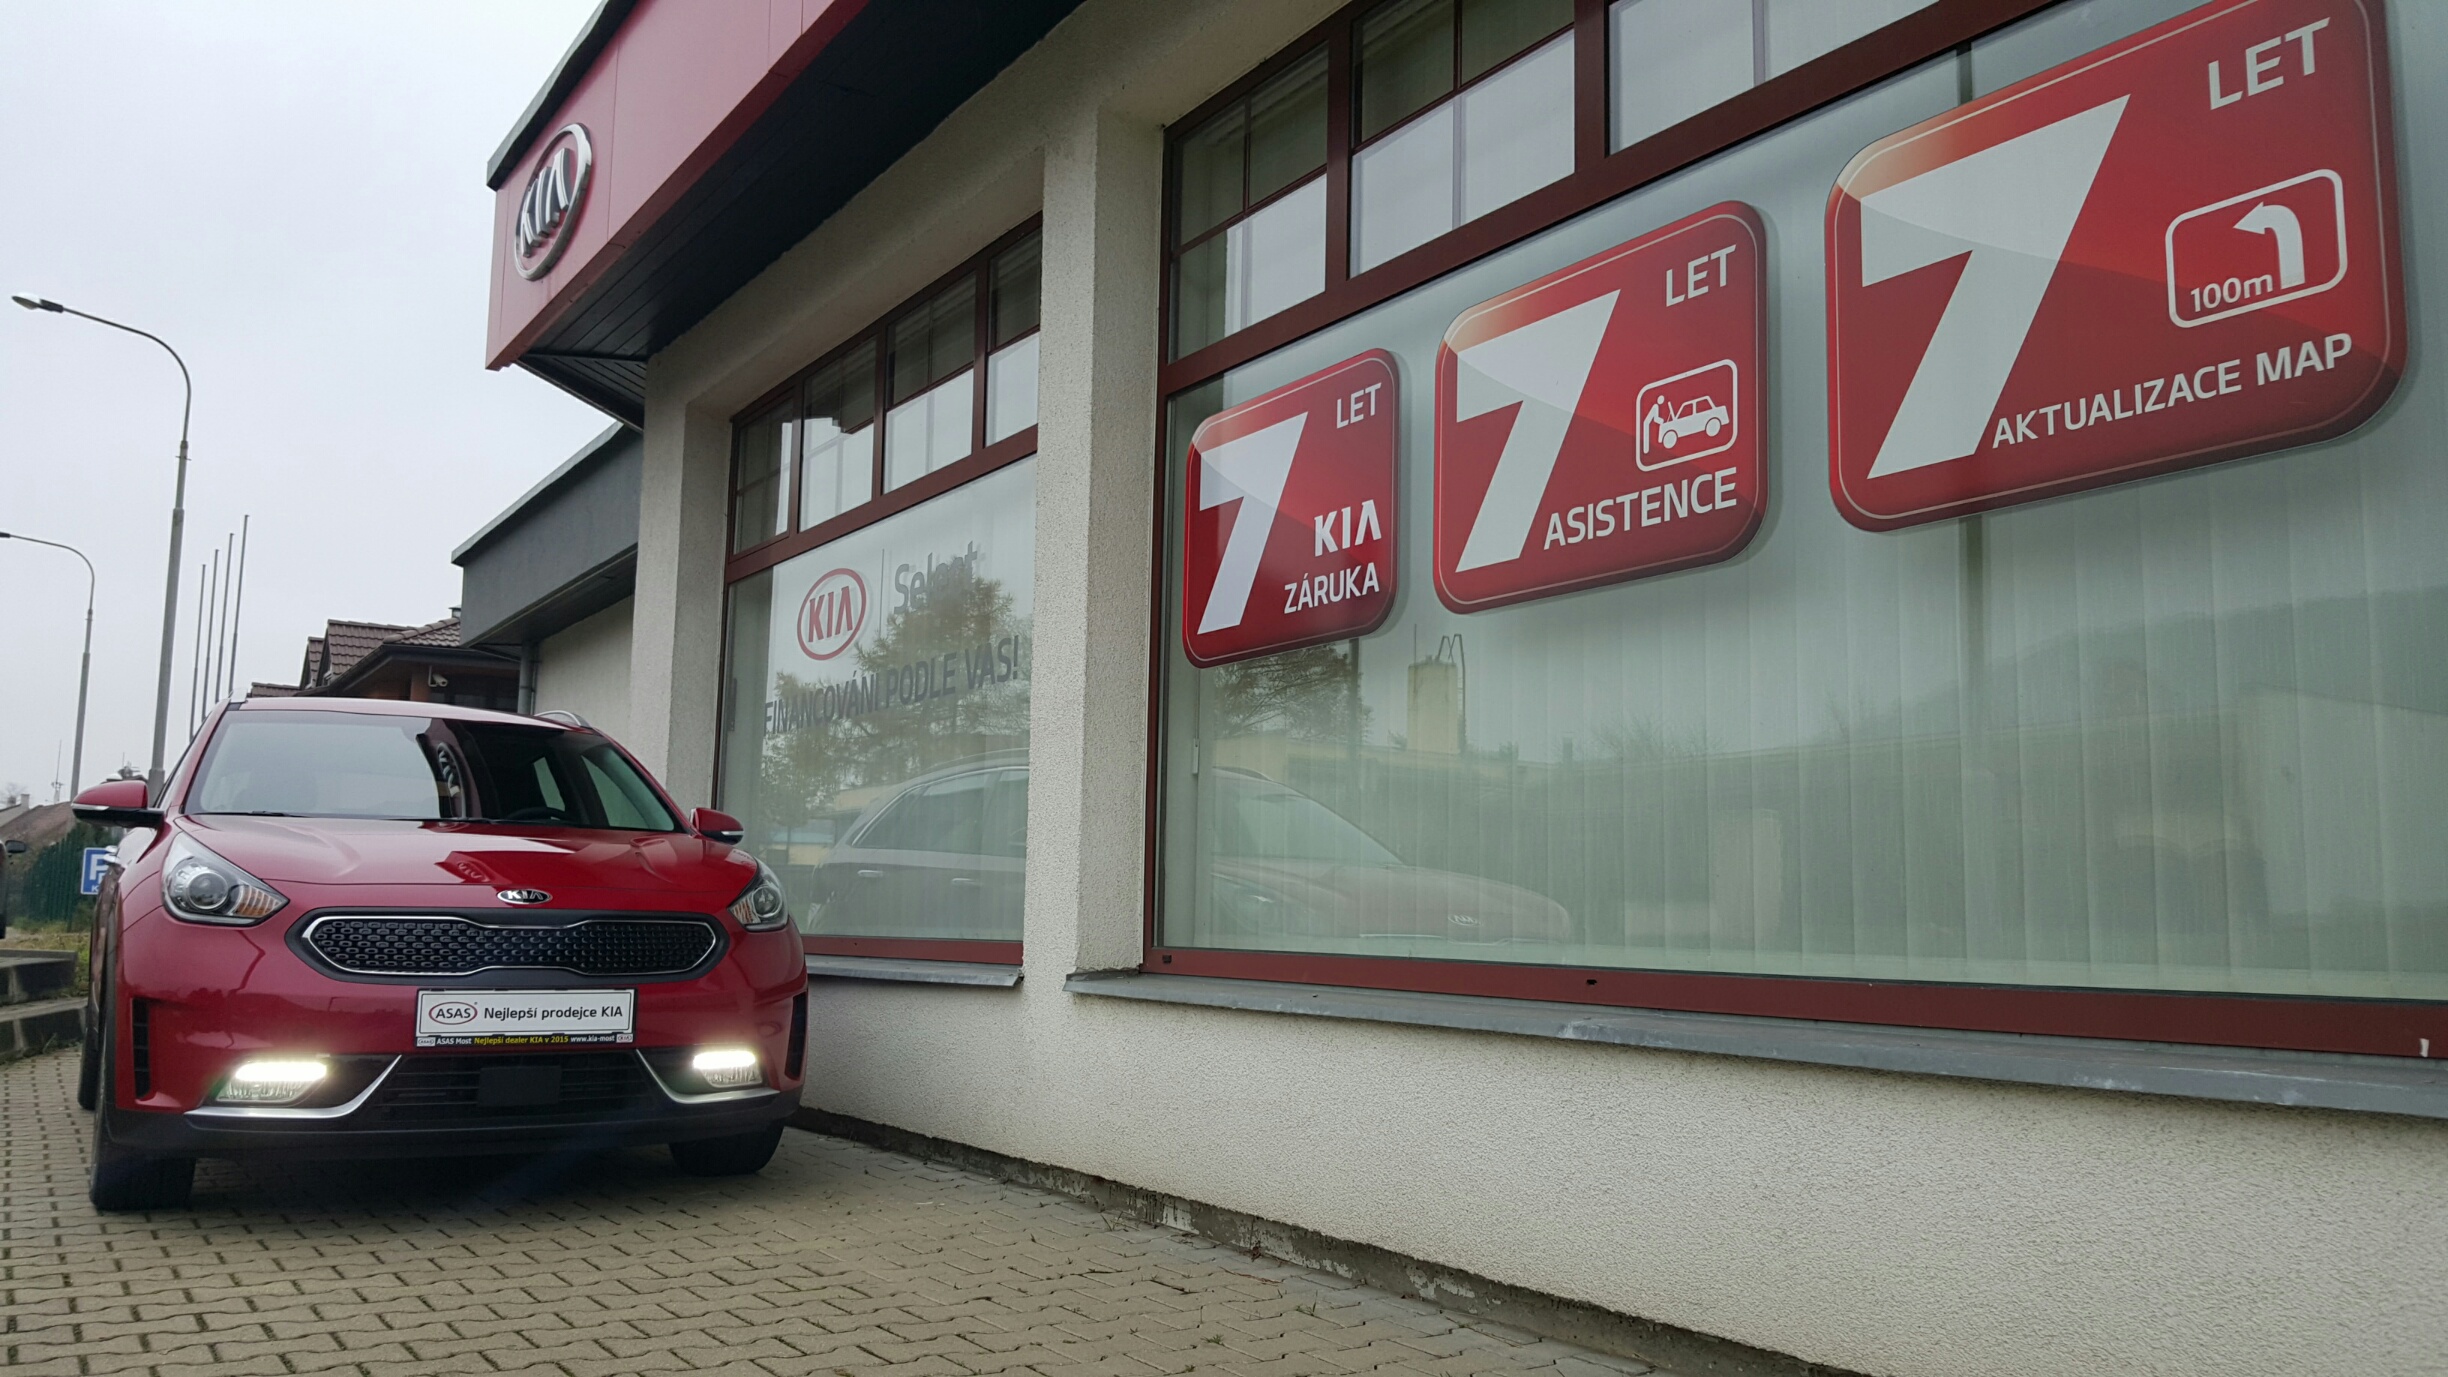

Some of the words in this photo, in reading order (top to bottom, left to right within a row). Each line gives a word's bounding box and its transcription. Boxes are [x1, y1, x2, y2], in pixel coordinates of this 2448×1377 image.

[2208, 17, 2331, 110] LET
[520, 147, 573, 258] KIA
[1665, 244, 1737, 307] LET
[1860, 93, 2131, 480] 7
[2190, 273, 2273, 313] 100m
[1337, 382, 1382, 429] LET
[1991, 359, 2242, 449] AKTUALIZACE
[2255, 333, 2353, 386] MAP
[1455, 288, 1621, 573] 7
[1197, 411, 1309, 635] 7
[1314, 499, 1382, 557] KIA
[1543, 467, 1738, 550] ASISTENCE
[808, 586, 853, 643] KIA
[1284, 562, 1380, 614] ZÁRUKA
[886, 652, 957, 708] PODLE
[507, 890, 544, 900] KIA
[435, 1008, 471, 1019] ASAS
[474, 1036, 504, 1045] Nejlepší
[529, 1035, 543, 1043] KIA
[550, 1035, 569, 1043] 2015
[484, 1007, 537, 1021] Nejlepší
[541, 1007, 597, 1020] prodejce
[601, 1006, 623, 1017] KIA
